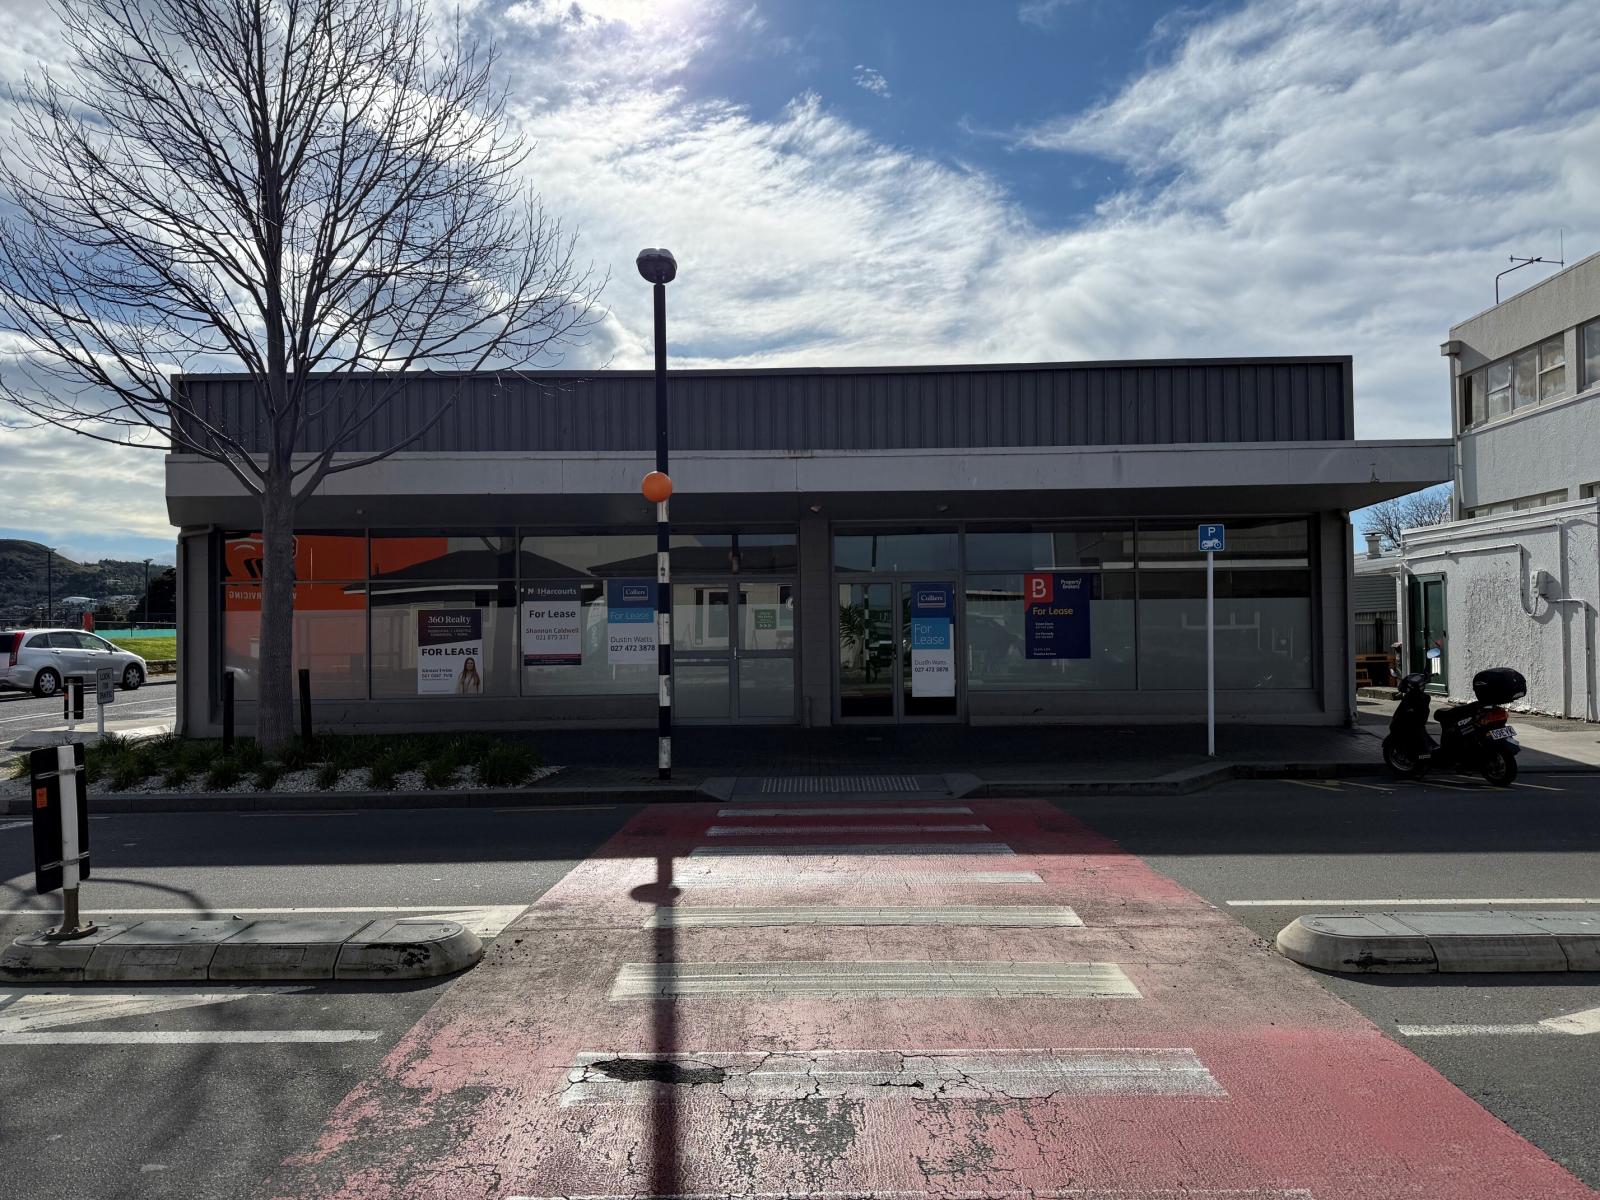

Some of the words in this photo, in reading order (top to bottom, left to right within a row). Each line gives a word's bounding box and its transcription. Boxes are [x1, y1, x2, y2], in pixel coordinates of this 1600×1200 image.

[1207, 526, 1216, 537] P
[1032, 578, 1047, 598] B
[529, 610, 546, 618] For
[547, 610, 577, 618] Lease
[609, 611, 624, 620] For
[1032, 607, 1046, 616] For
[1048, 607, 1074, 616] Lease
[427, 616, 444, 624] 360
[445, 615, 472, 625] Realty
[914, 623, 933, 634] For
[914, 634, 945, 645] Lease
[421, 648, 443, 656] FOR
[444, 647, 479, 656] LEASE
[638, 644, 656, 652] 3878
